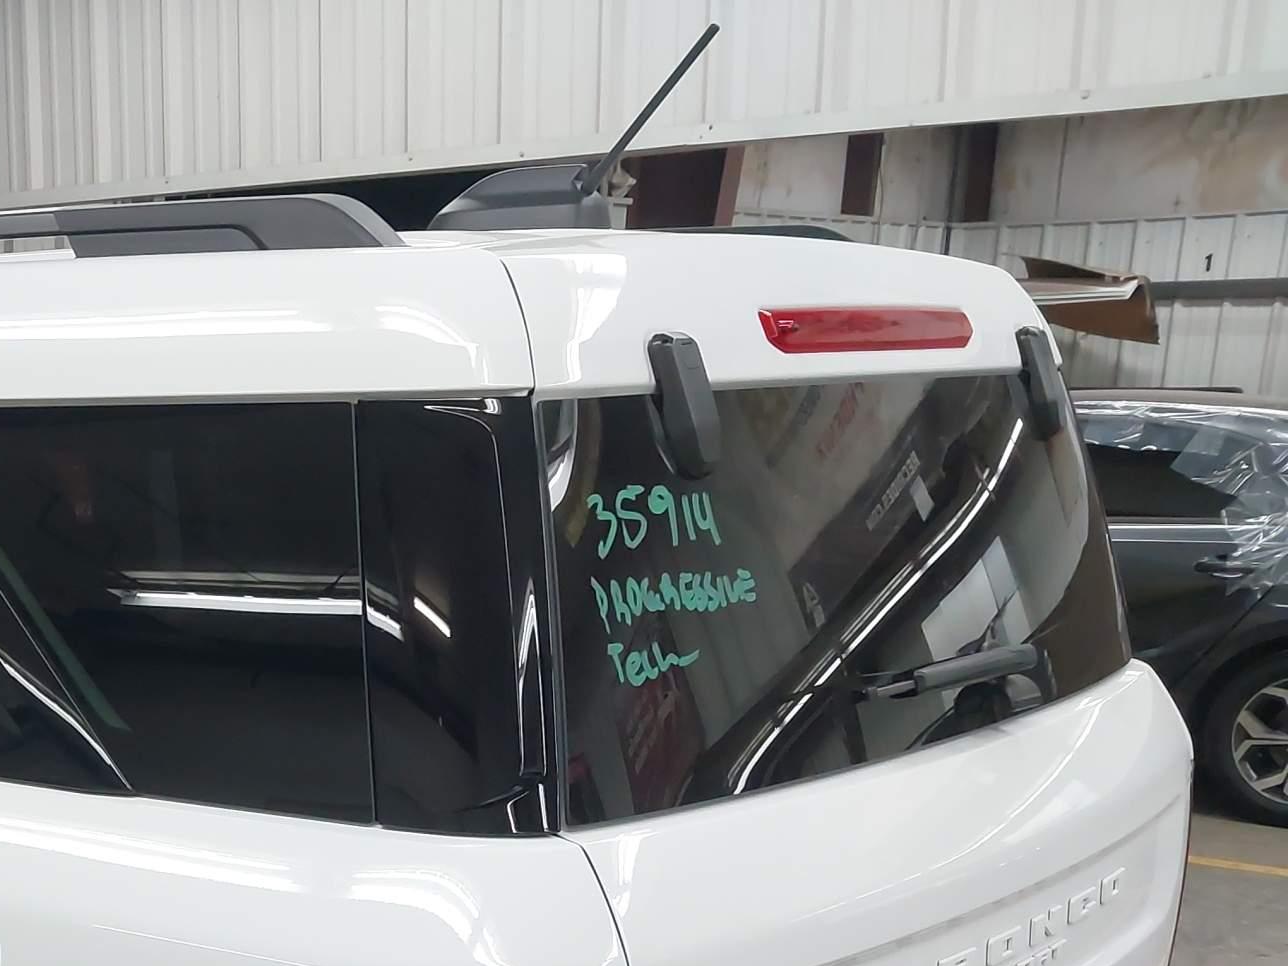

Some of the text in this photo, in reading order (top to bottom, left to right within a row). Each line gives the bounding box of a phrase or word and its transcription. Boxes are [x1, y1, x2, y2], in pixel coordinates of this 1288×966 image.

[1204, 252, 1215, 273] 1
[585, 484, 722, 560] 35914
[590, 568, 757, 635] PROGRESSIVE
